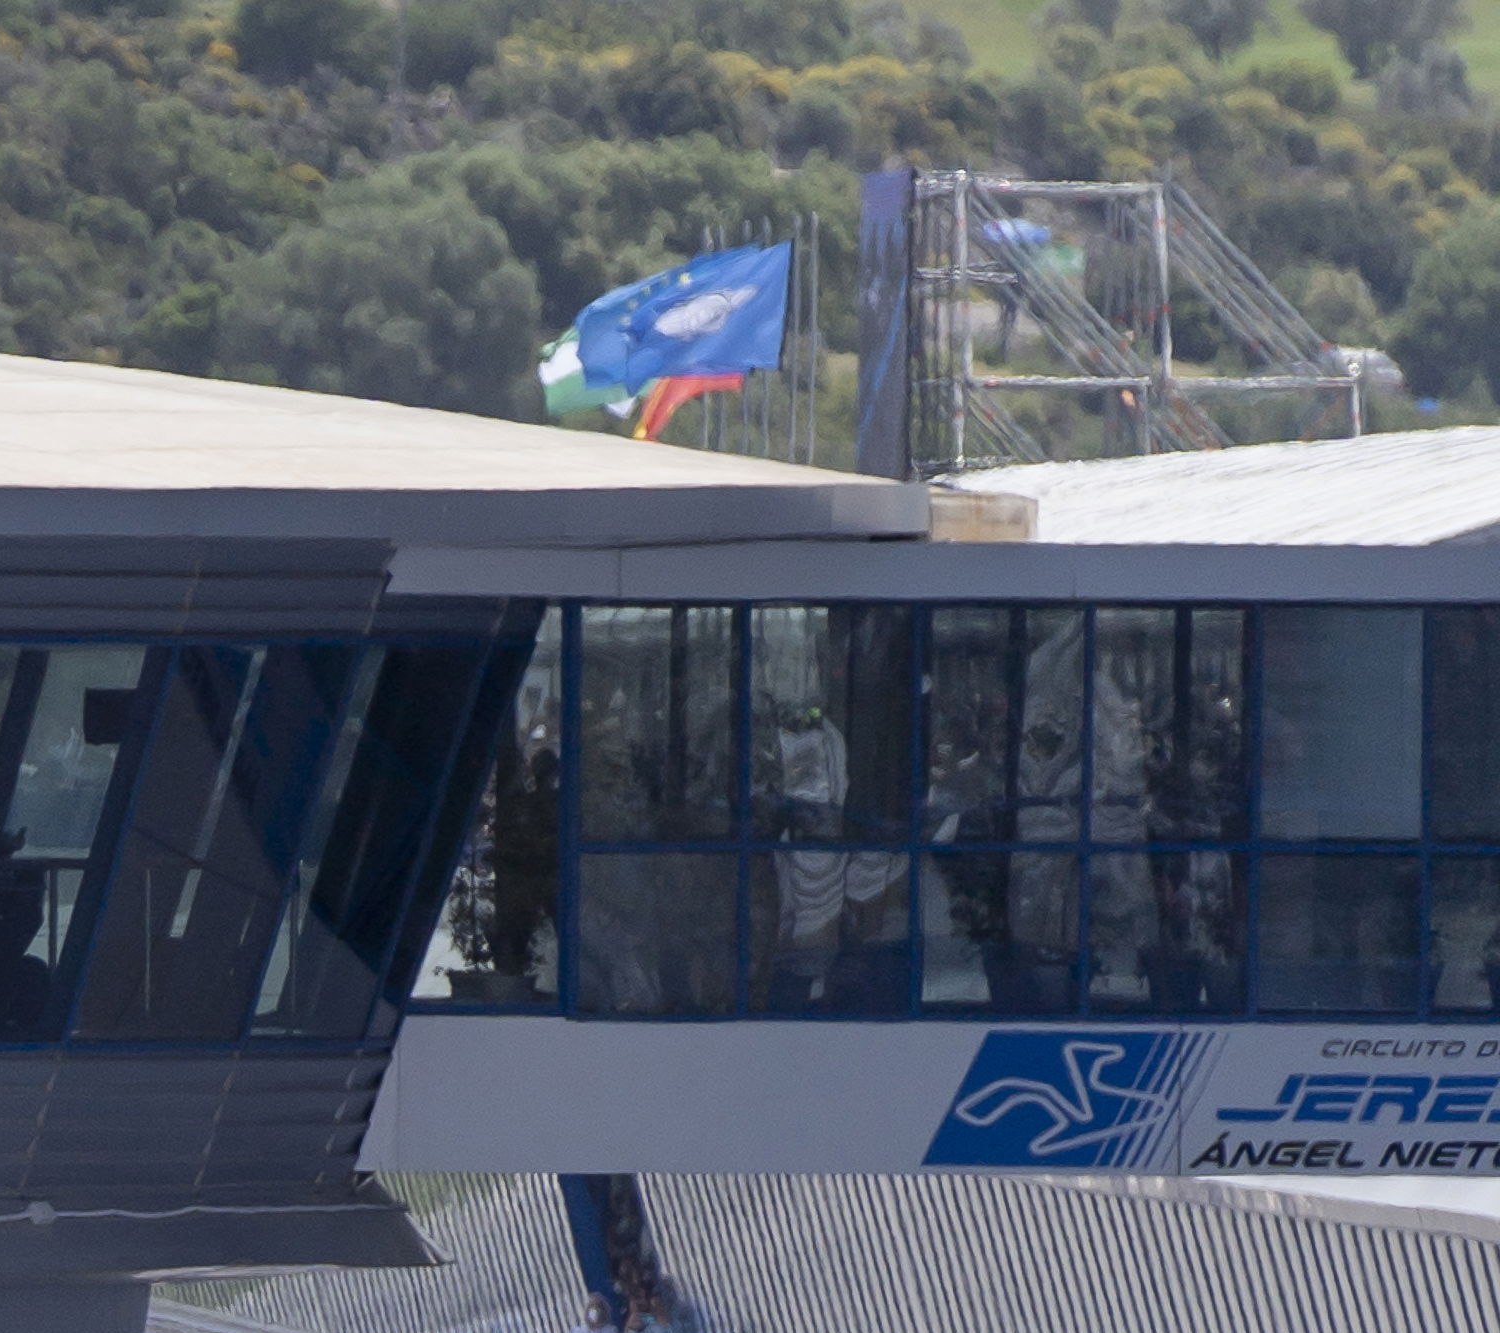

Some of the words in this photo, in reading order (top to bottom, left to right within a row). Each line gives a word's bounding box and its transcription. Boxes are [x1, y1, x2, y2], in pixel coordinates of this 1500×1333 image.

[1320, 1039, 1466, 1058] CIRCUITO
[1476, 1039, 1500, 1058] D
[1217, 1073, 1500, 1123] JERE
[1189, 1131, 1365, 1169] ÁNGEL
